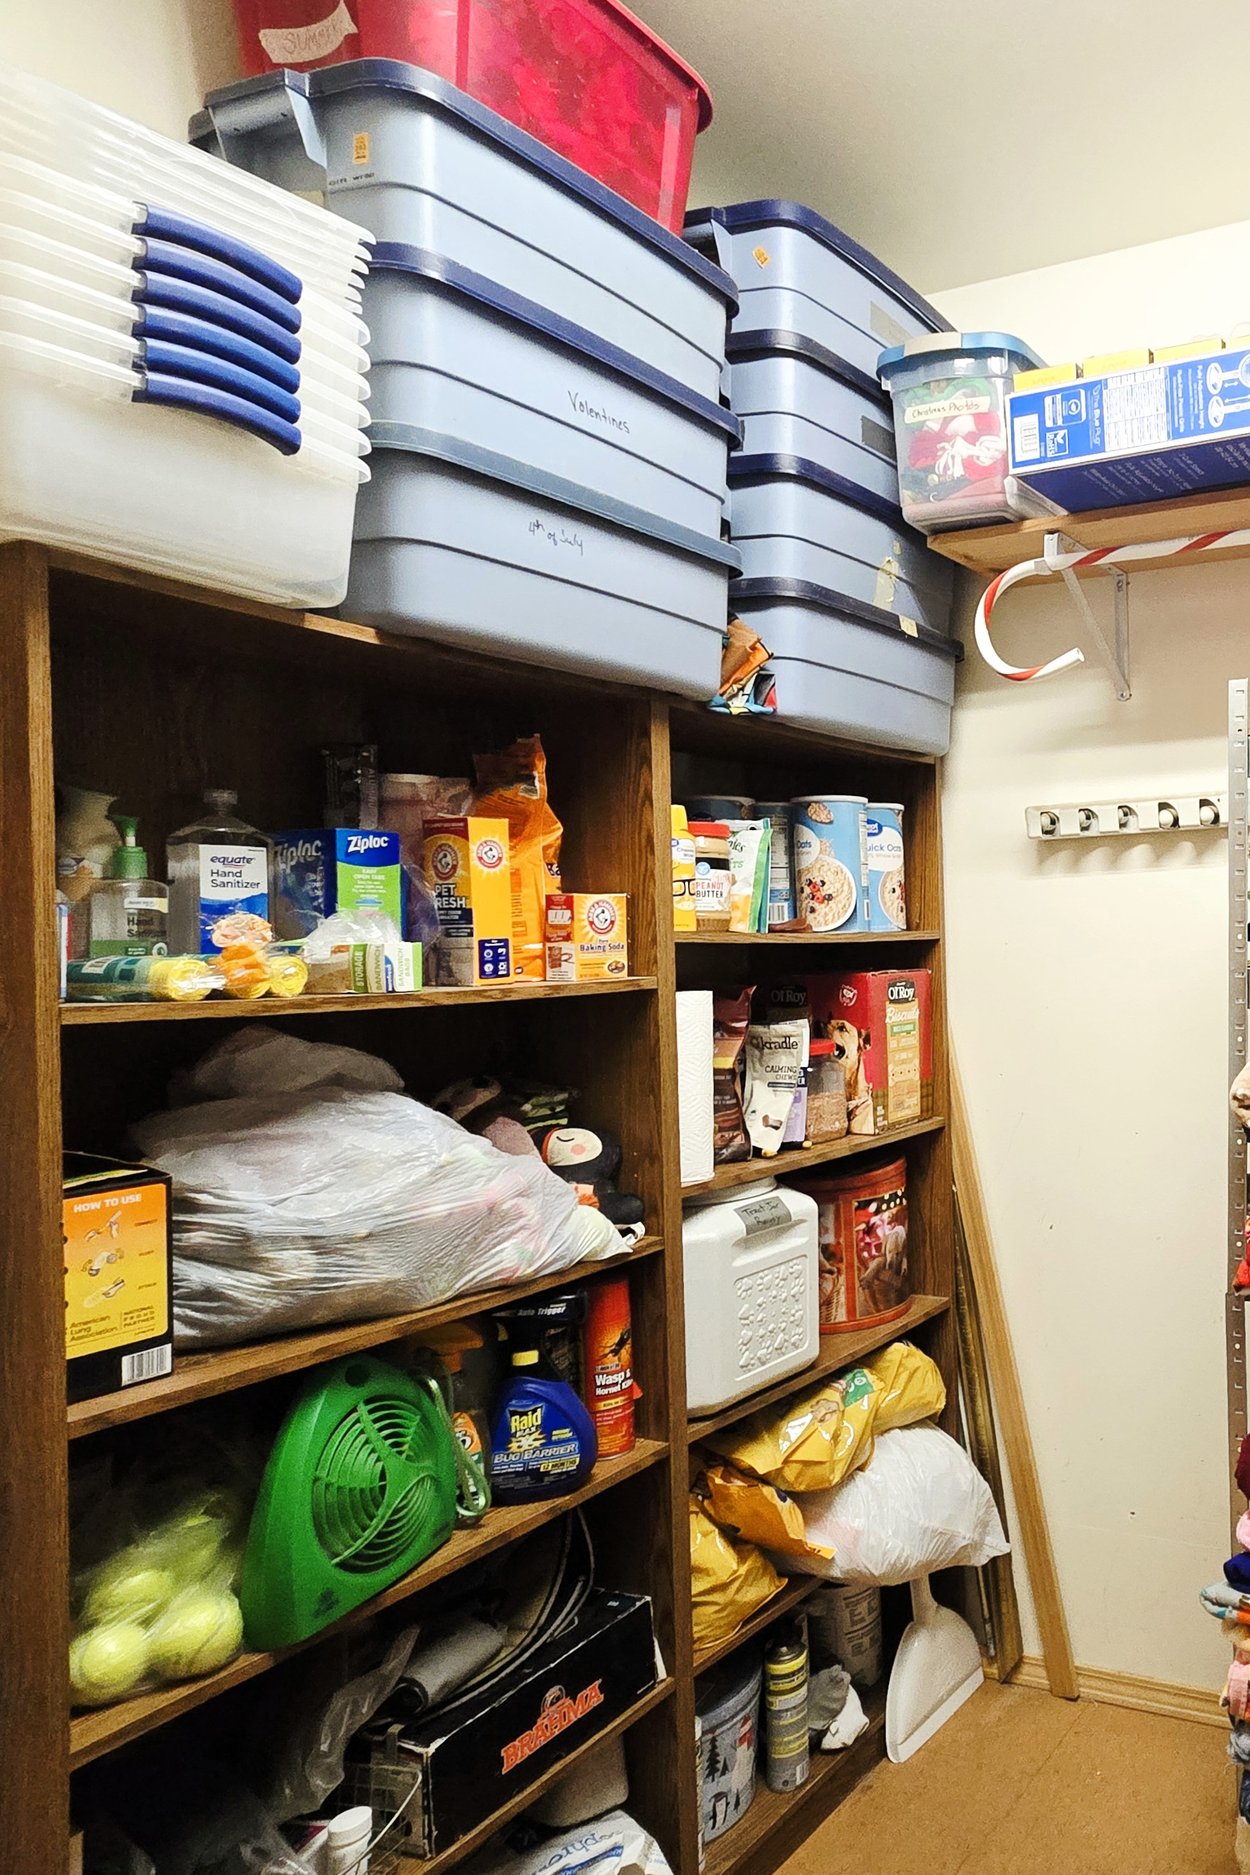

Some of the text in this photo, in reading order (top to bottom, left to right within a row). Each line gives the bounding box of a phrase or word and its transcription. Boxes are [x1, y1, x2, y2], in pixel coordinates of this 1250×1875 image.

[347, 835, 389, 853] Ziploc
[867, 843, 884, 852] uick
[210, 855, 254, 867] equate
[210, 869, 243, 879] Hand
[210, 879, 261, 890] Sanitizer
[435, 884, 456, 896] PET
[696, 881, 724, 890] PEANUT
[696, 890, 724, 898] BUTTER
[579, 943, 625, 952] Baking Soda
[354, 951, 365, 988] STORAGE
[74, 1193, 142, 1213] HOW TO USE
[517, 1304, 567, 1317] Auto Trigger
[595, 1371, 625, 1386] Wasp
[595, 1384, 621, 1396] Hornet
[511, 1407, 542, 1433] Raid
[516, 1426, 537, 1437] MAX
[493, 1443, 577, 1464] BUG BARRIER
[501, 1681, 604, 1775] BRAHMA
